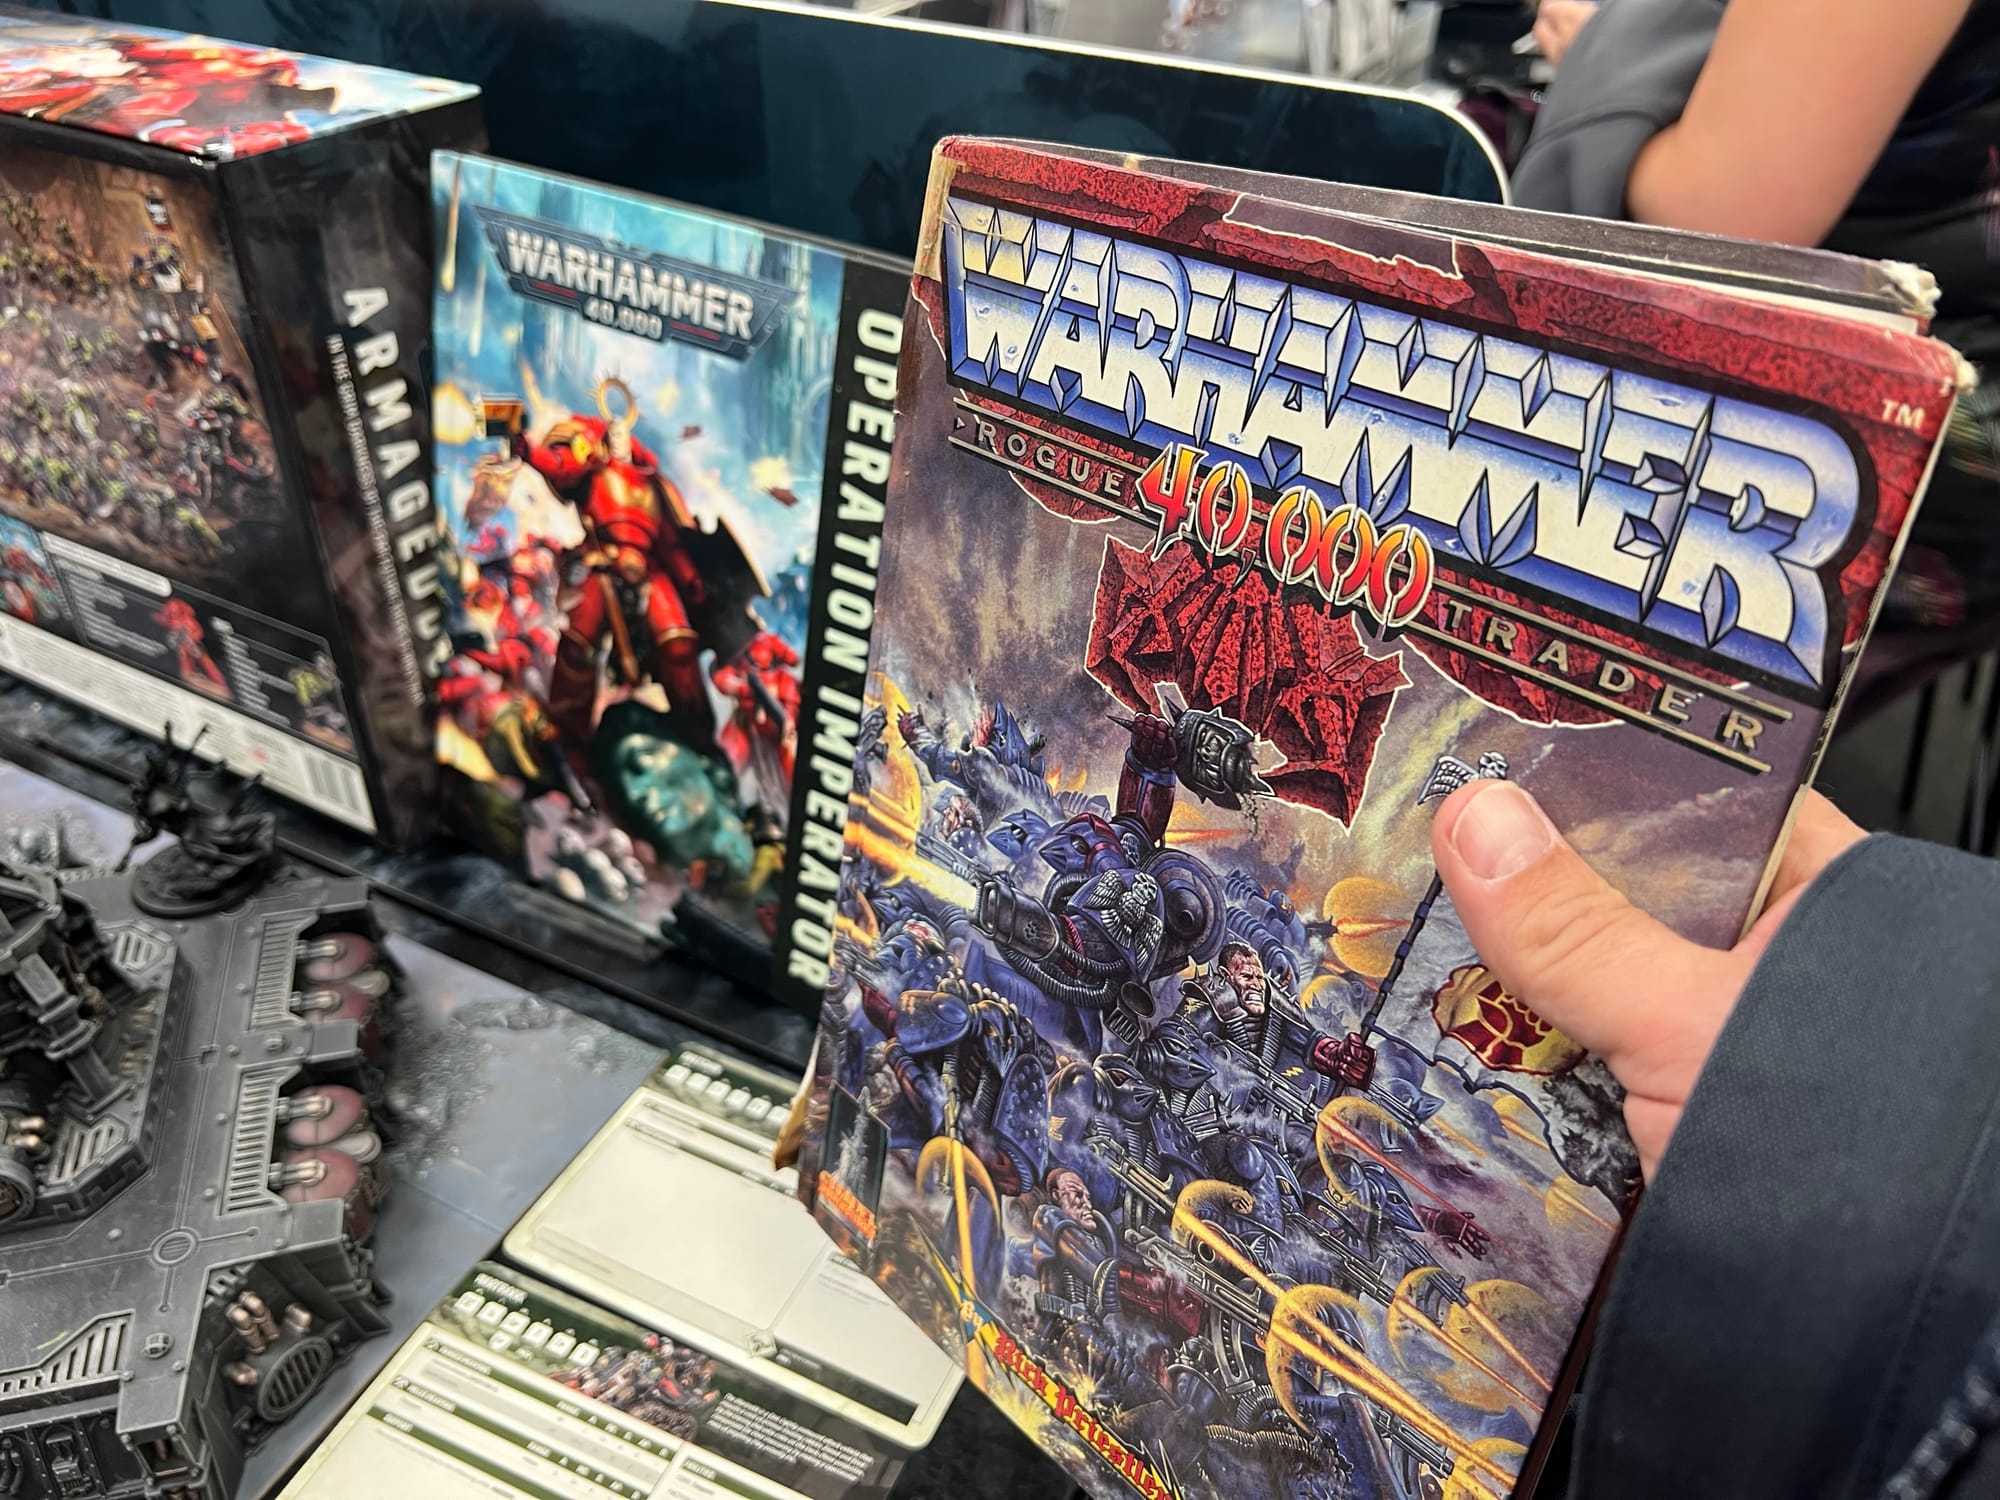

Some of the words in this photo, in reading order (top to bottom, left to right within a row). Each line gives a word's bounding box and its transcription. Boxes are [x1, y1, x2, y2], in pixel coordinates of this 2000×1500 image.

[505, 227, 754, 341] WARHAMMER
[585, 299, 664, 341] 40,000
[822, 308, 904, 675] OPERATION
[944, 195, 1861, 687] WARHAMMER
[1881, 398, 1926, 430] TM
[977, 417, 1126, 497] ROGUE
[1444, 598, 1766, 750] TRADER
[1136, 441, 1435, 628] 40,000
[787, 685, 864, 990] IMPERATOR
[994, 1327, 1048, 1397] Rick
